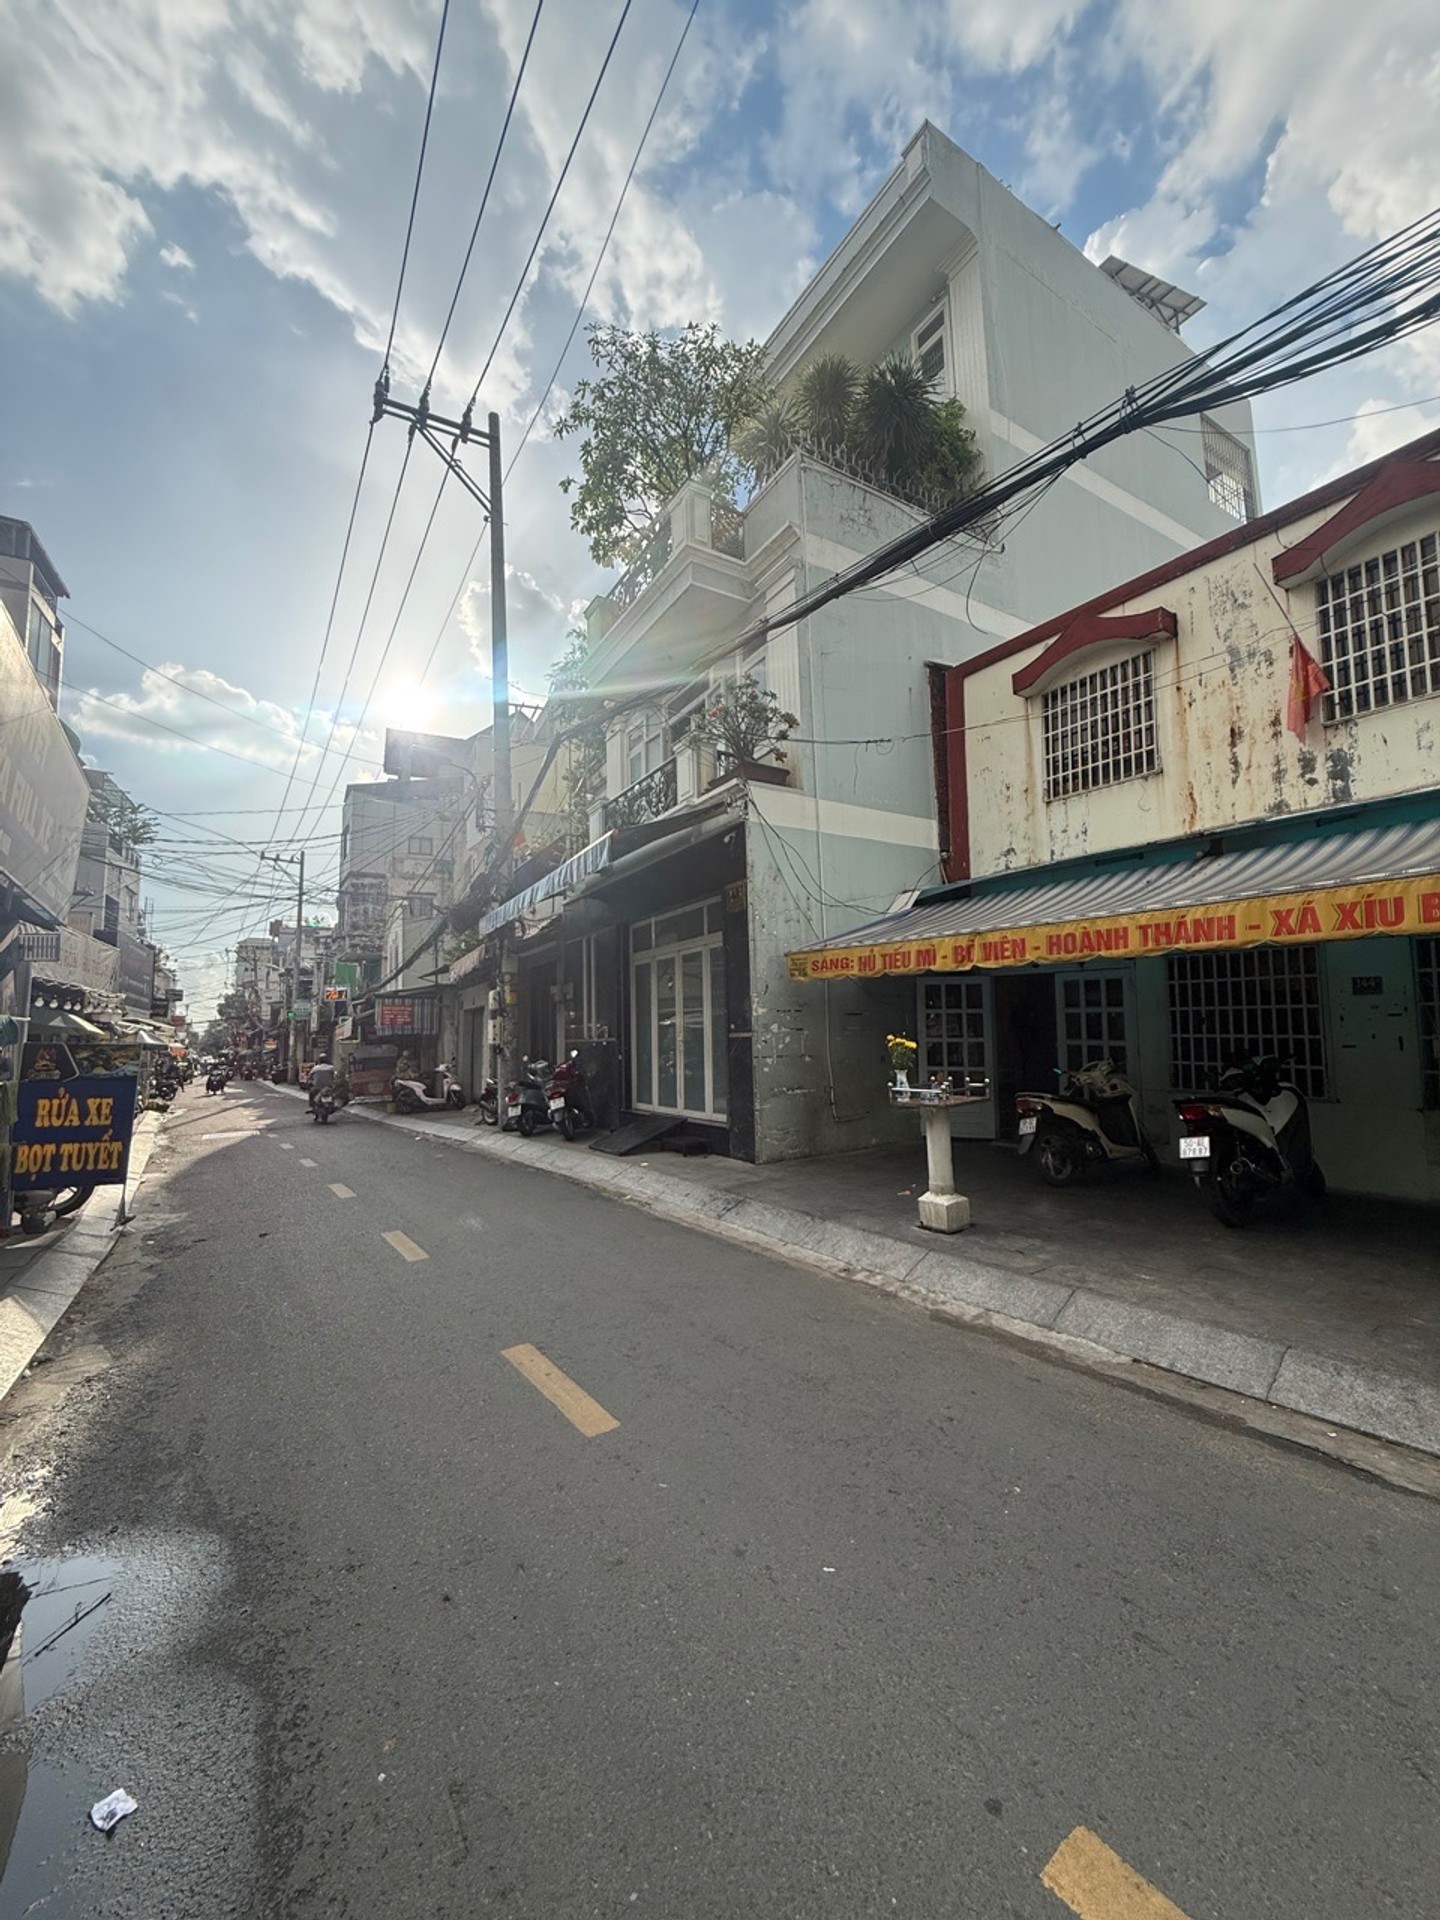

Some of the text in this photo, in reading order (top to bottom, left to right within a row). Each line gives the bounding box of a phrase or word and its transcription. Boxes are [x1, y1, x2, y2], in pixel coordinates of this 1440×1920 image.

[880, 945, 913, 971] TIẾU
[916, 944, 937, 967] MÌ
[981, 935, 1027, 962] VIÊN
[1046, 926, 1129, 956] HOÀNH
[1137, 914, 1236, 948] THÁNH
[1269, 900, 1322, 937] XÁ
[1333, 892, 1406, 932] XÍU
[34, 1087, 114, 1128] RỬA XE
[14, 1128, 123, 1181] BỌT TUYẾT
